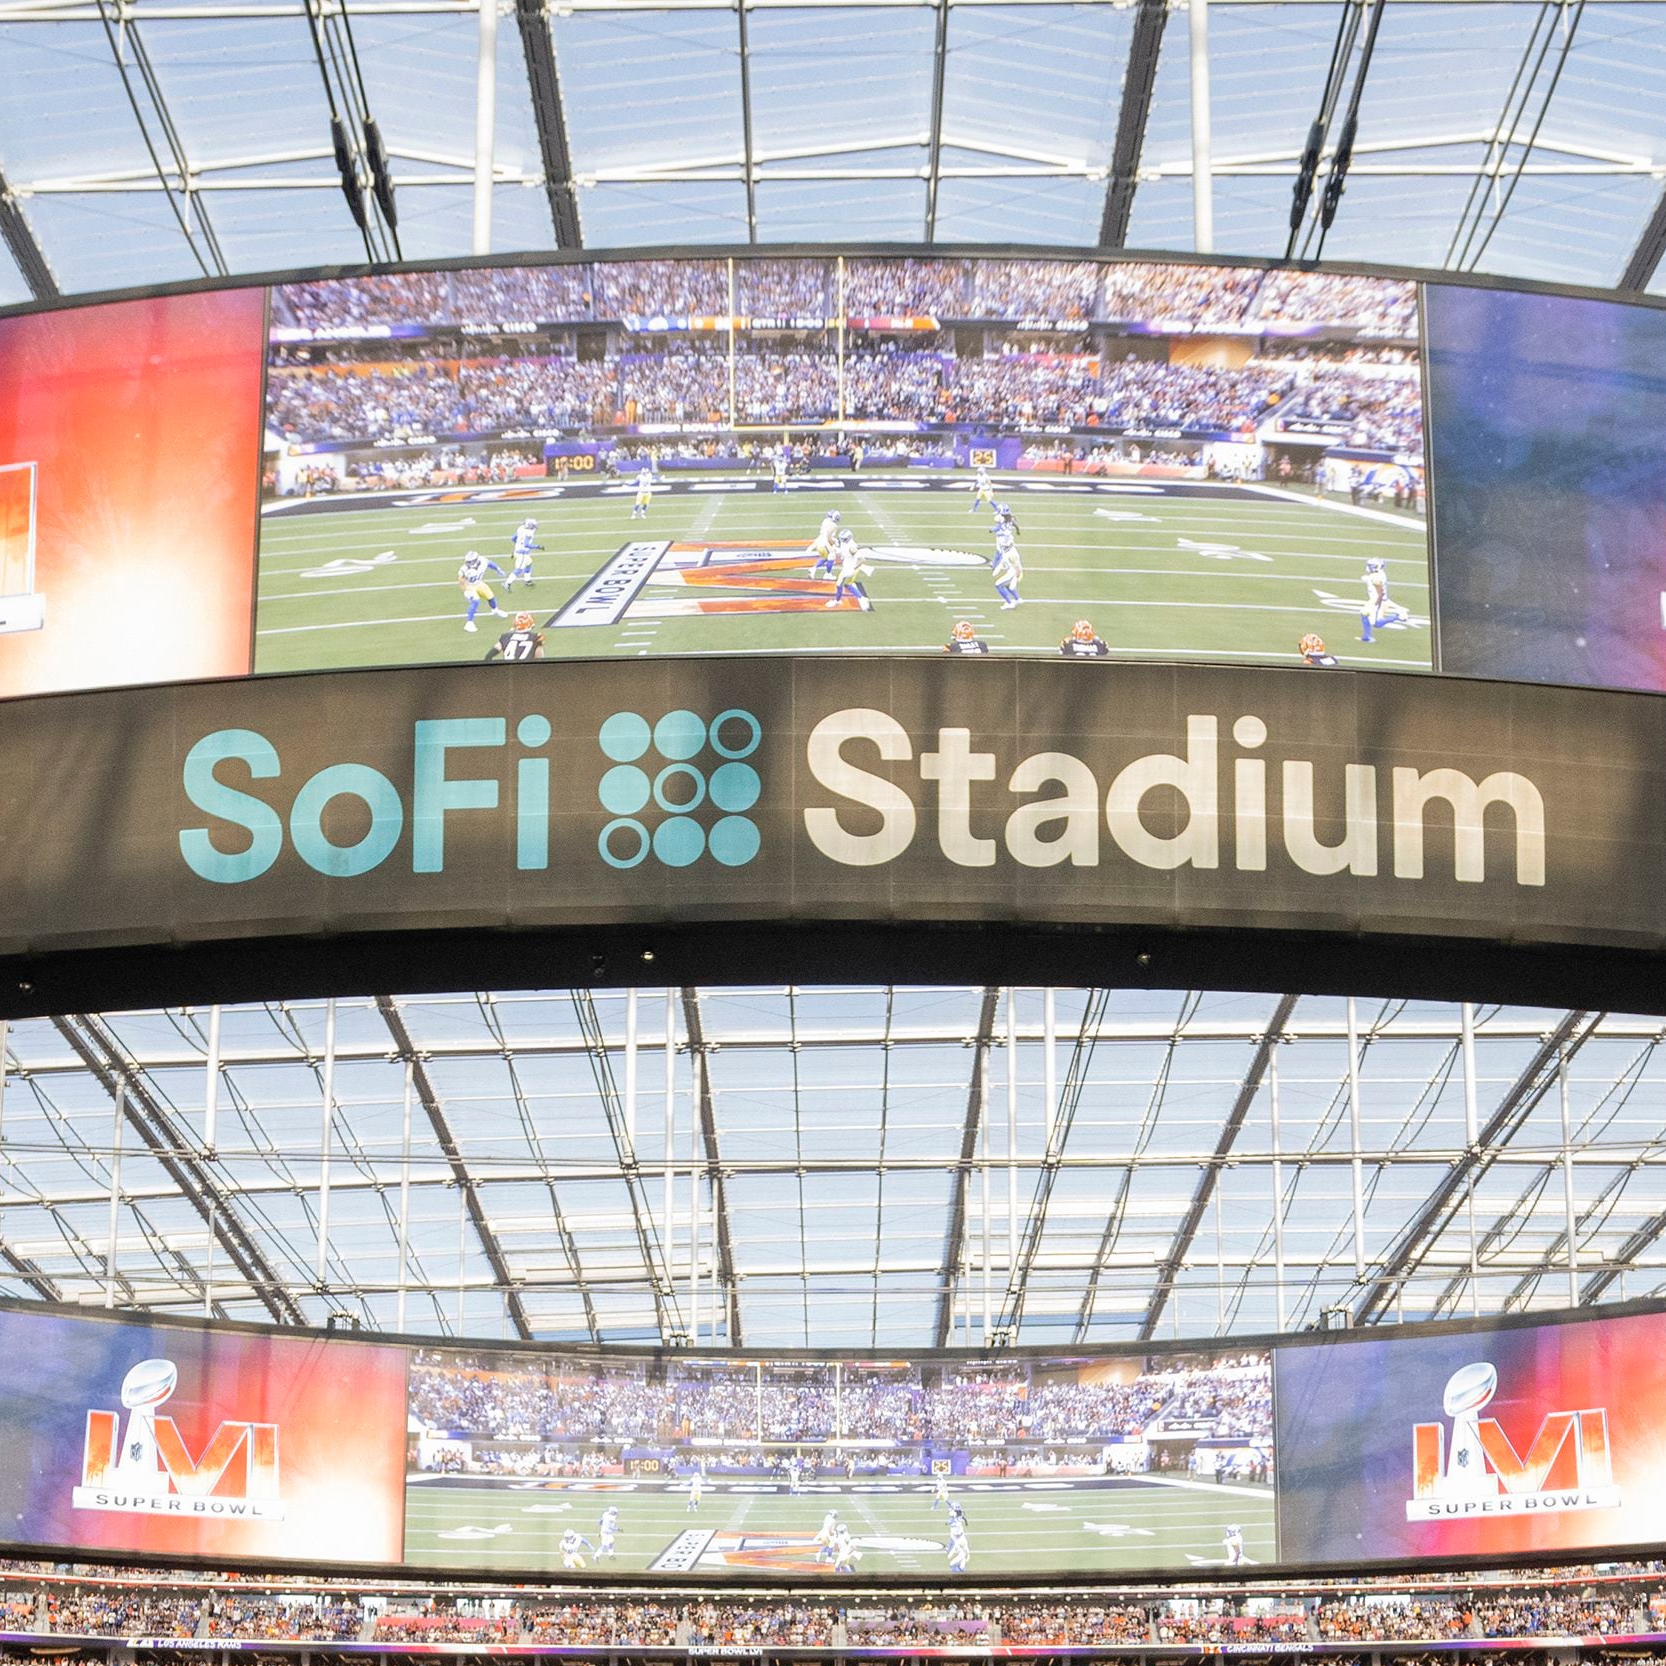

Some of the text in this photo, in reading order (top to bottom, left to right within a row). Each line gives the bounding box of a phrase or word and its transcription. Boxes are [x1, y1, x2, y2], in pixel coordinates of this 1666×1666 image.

[178, 708, 1547, 888] SoFi Stadium
[81, 1407, 281, 1498] LVI
[1411, 1407, 1613, 1498] LVI
[93, 1494, 264, 1518] SUPER BOWL
[1428, 1494, 1600, 1518] SUPER BOWL
